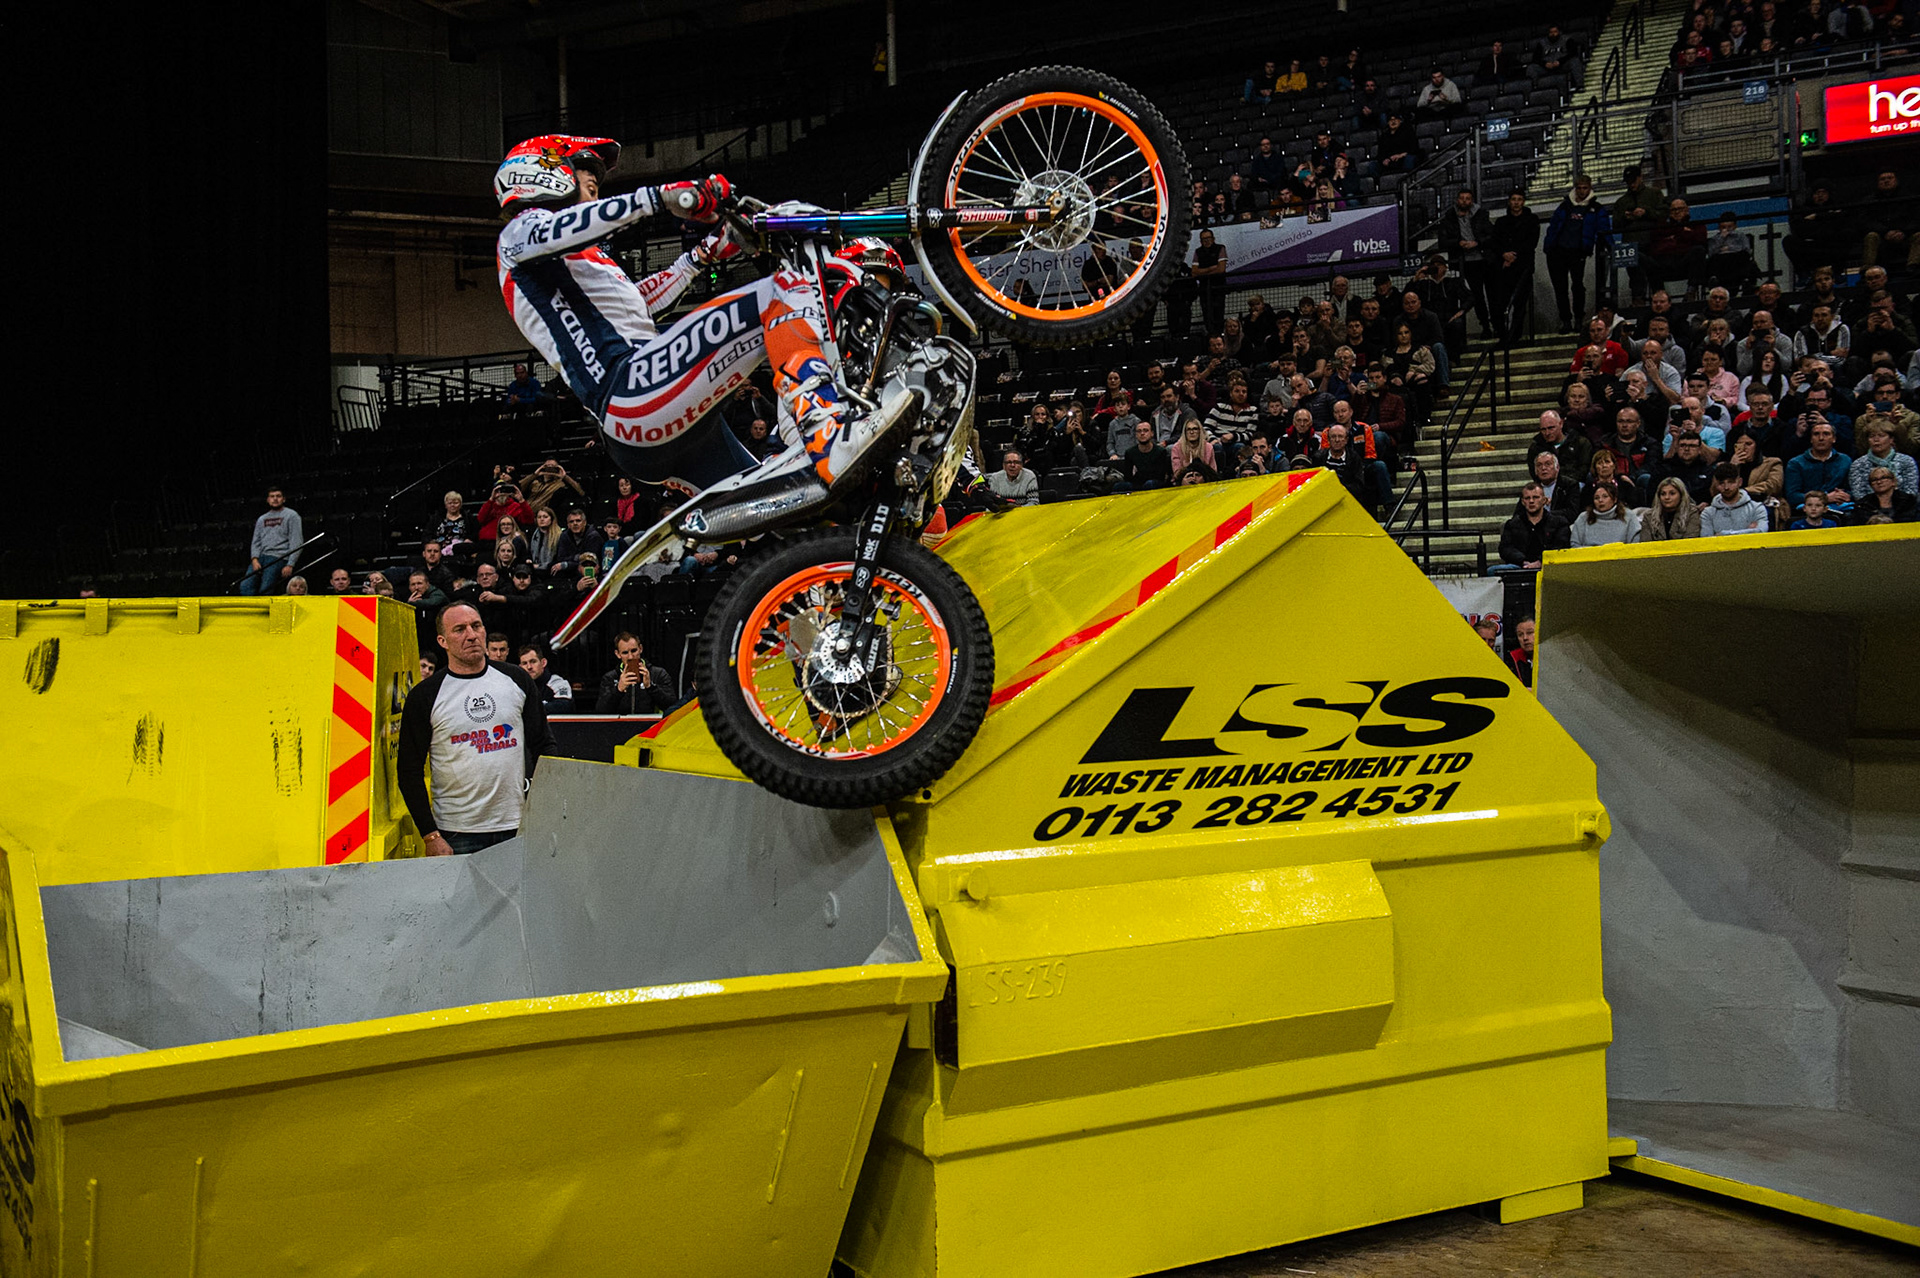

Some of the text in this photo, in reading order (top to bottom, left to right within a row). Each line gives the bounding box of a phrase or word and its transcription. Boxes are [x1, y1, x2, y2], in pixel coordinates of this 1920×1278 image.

[1745, 84, 1765, 96] 218
[1489, 123, 1507, 133] 219
[1893, 122, 1908, 132] up
[528, 195, 643, 245] REPSOL
[961, 209, 1007, 222] SHOWA
[1142, 212, 1167, 271] REPSOL
[1614, 248, 1635, 259] 118
[1403, 258, 1422, 268] 119
[550, 287, 607, 385] HONDA
[627, 302, 748, 390] REPSOL
[707, 332, 764, 382] hebo
[615, 372, 743, 443] Montesa
[871, 503, 889, 534] DID
[862, 538, 876, 561] NGK
[866, 636, 881, 673] GALFER
[472, 697, 486, 708] 25
[1078, 676, 1511, 765] LSS
[451, 730, 489, 745] ROAD
[470, 738, 491, 747] AND
[476, 738, 518, 754] TRIALS
[764, 721, 828, 758] REPSOL
[1058, 752, 1474, 799] WASTE MANAGEMENT LTD
[1033, 781, 1462, 842] 0113 282 4531
